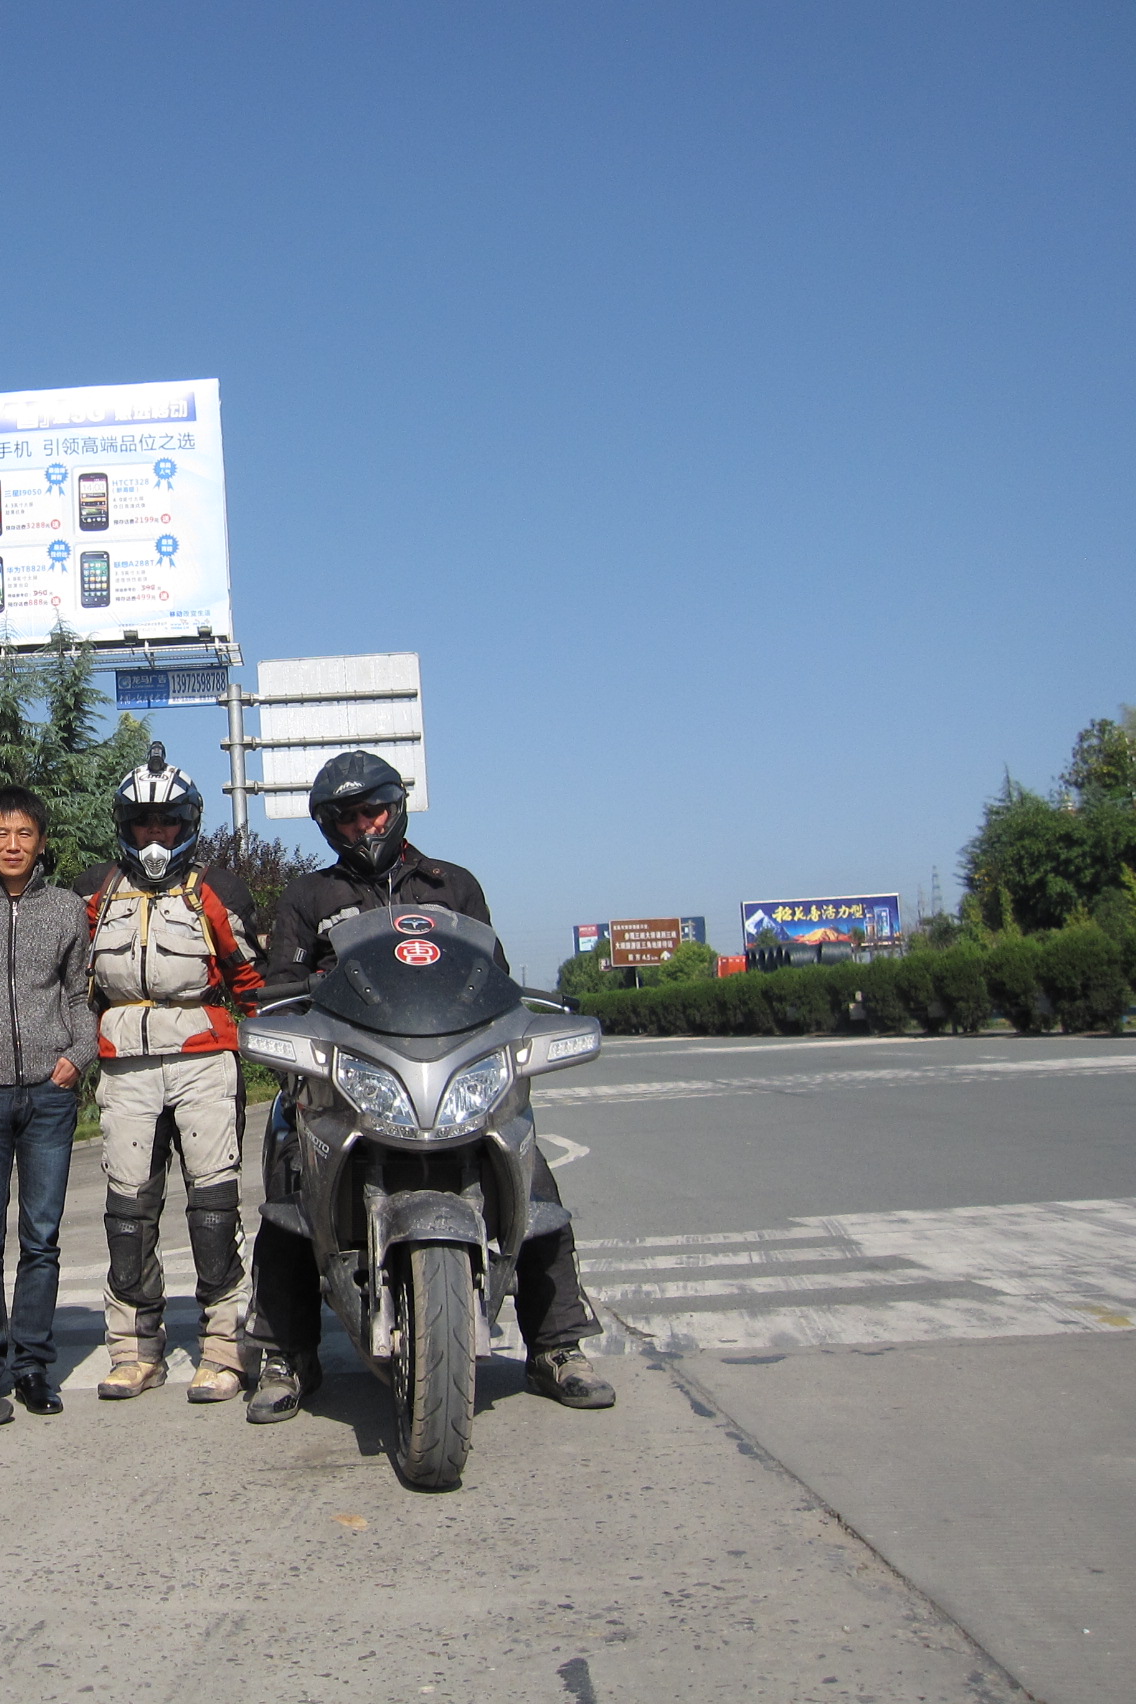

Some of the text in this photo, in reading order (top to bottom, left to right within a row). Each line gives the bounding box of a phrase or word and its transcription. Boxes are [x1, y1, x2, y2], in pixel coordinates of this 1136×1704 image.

[43, 433, 195, 457] 引领高端品位之选
[172, 672, 226, 693] 13972598788
